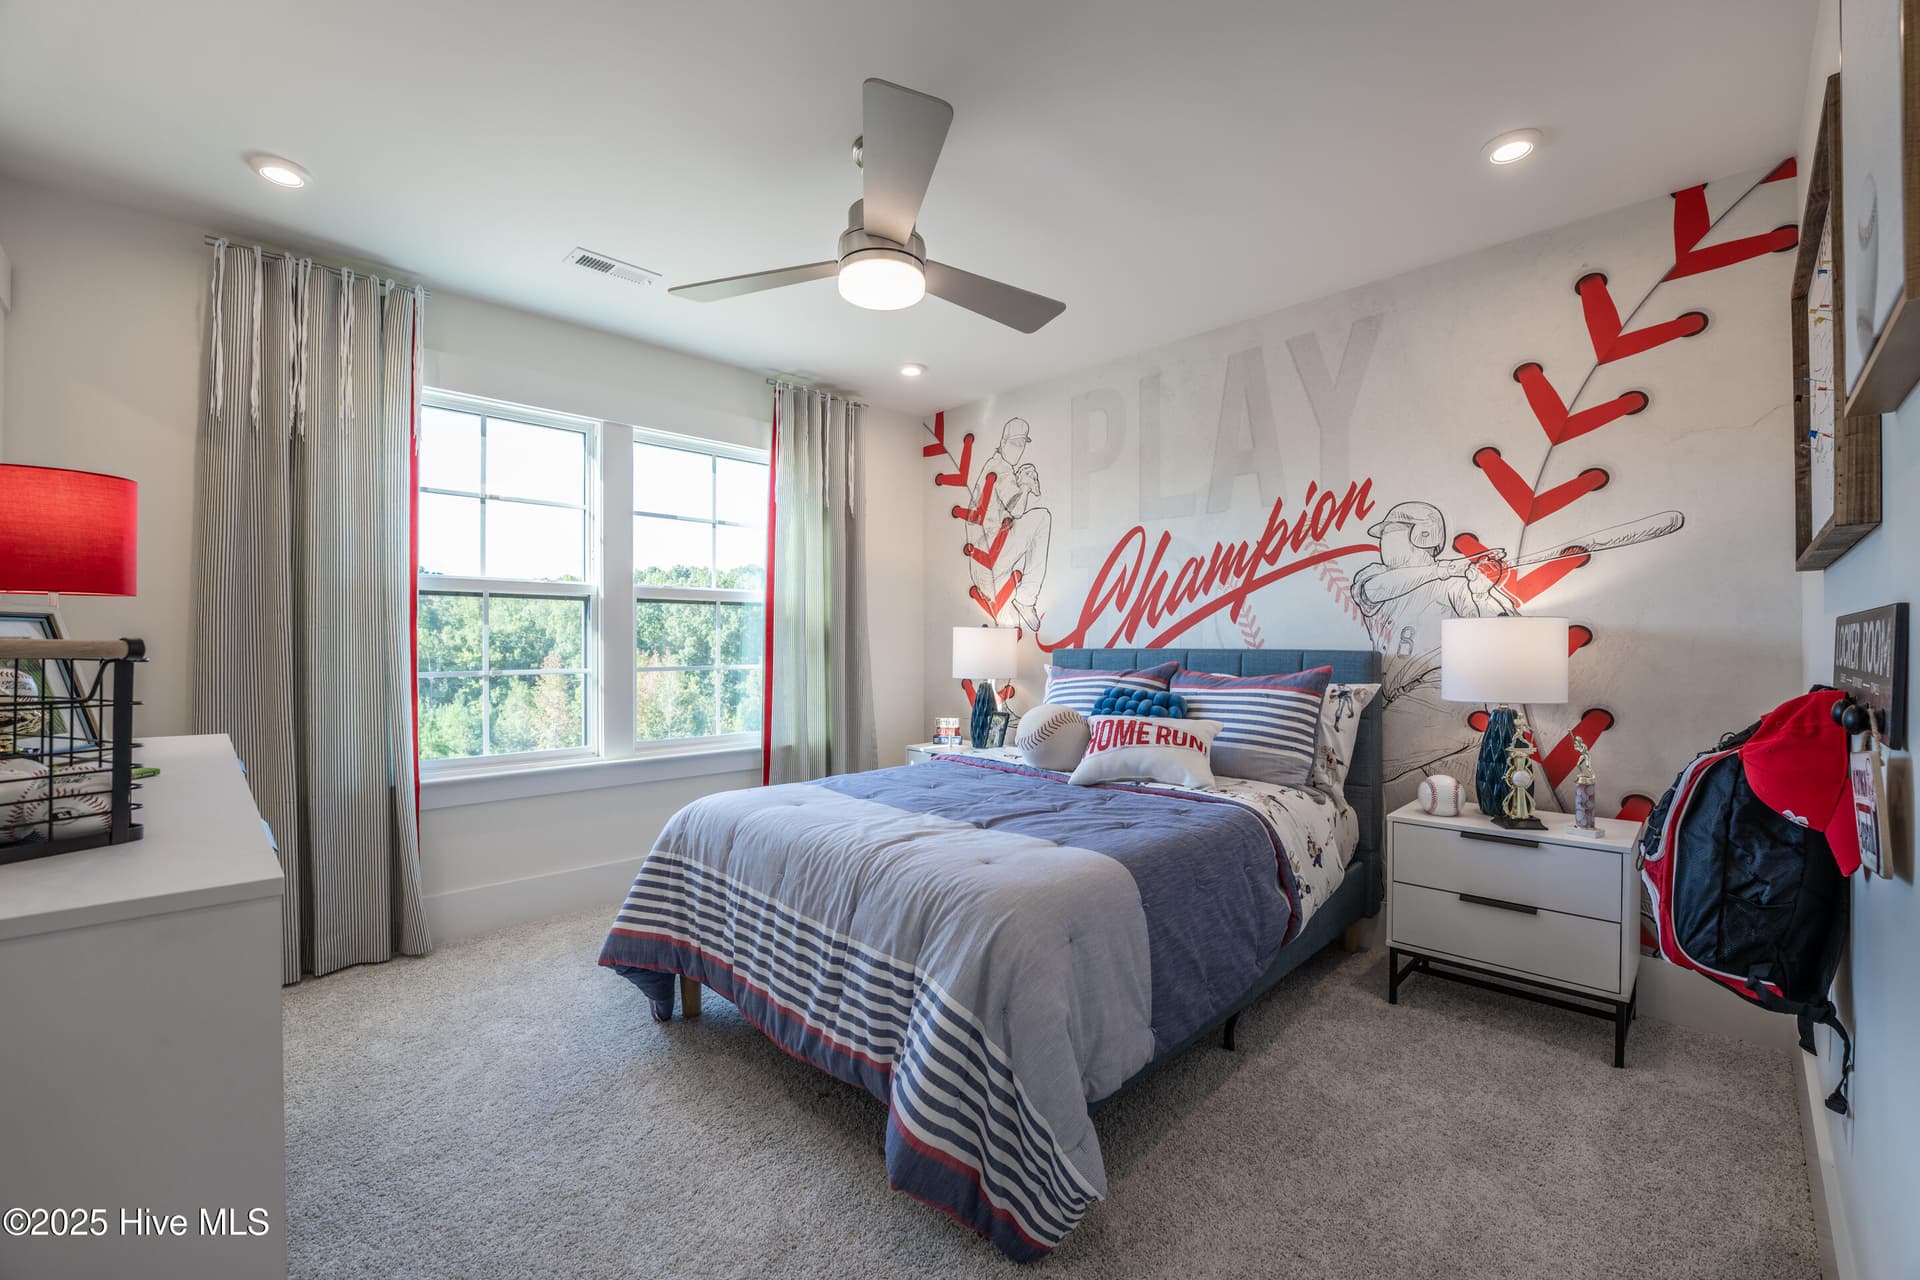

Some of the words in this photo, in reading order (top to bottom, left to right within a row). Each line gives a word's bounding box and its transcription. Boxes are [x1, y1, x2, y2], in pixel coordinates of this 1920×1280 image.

[1070, 312, 1385, 530] PLAY
[1036, 476, 1377, 652] Champion
[1836, 622, 1860, 671] LOCKER
[1861, 618, 1891, 678] ROOM
[1083, 718, 1153, 759] HOME
